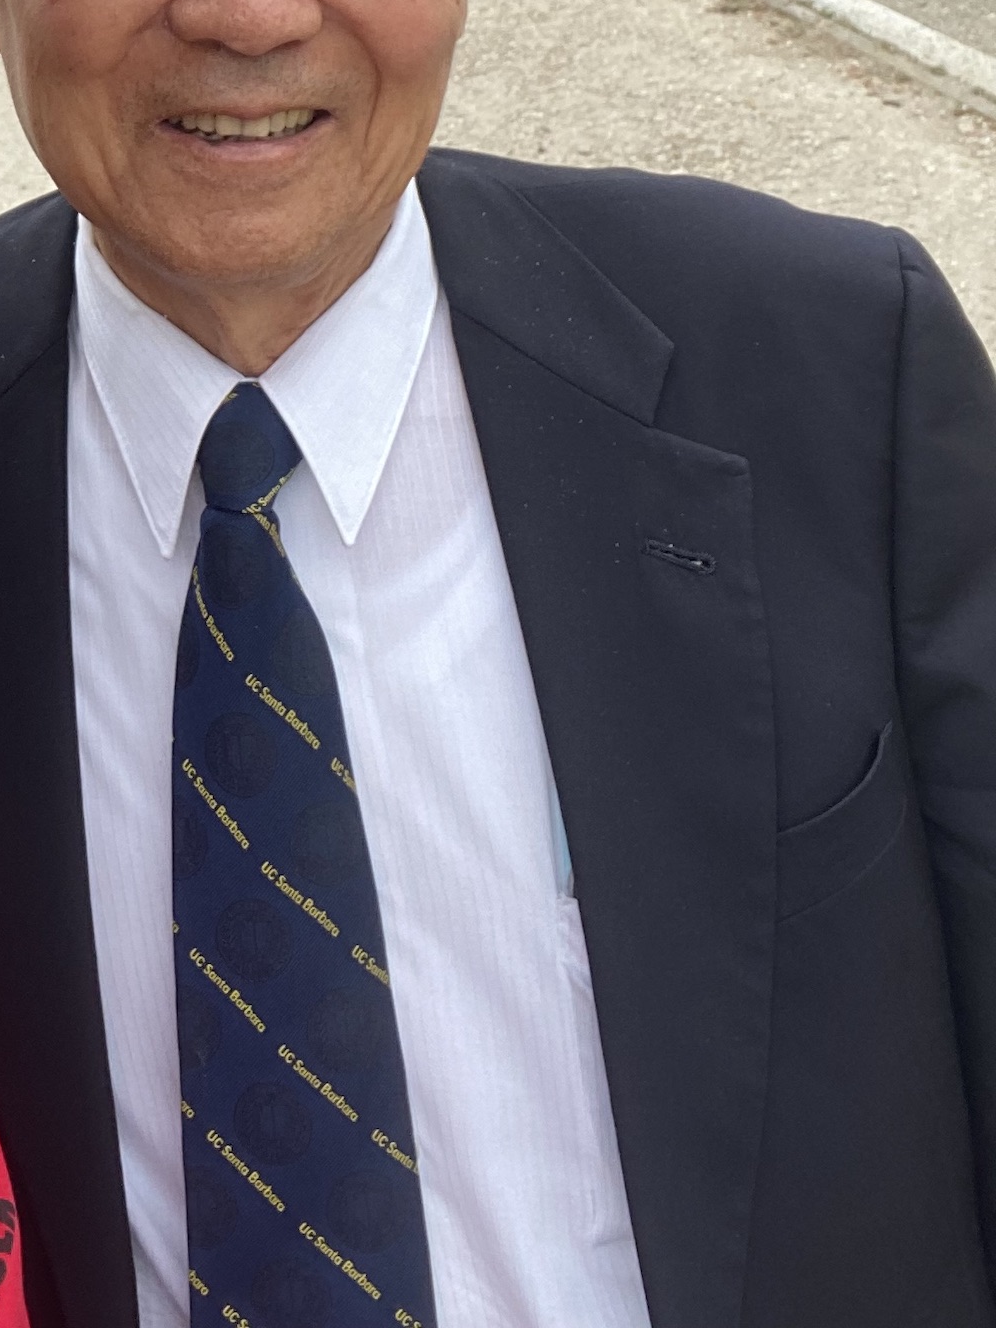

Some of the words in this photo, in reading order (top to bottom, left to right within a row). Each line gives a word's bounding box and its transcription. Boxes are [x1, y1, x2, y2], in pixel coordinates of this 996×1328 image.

[206, 615, 235, 662] Barbara
[245, 673, 263, 693] UC
[259, 686, 287, 717] Santa
[284, 709, 321, 750] Barbara
[182, 758, 197, 779] UC
[193, 776, 218, 810] Santa
[215, 805, 250, 850] Barbara
[330, 757, 345, 777] UC
[261, 861, 279, 880] UC
[275, 875, 305, 905] Santa
[302, 898, 340, 937] Barbara
[189, 947, 206, 967] UC
[203, 963, 231, 995] Santa
[229, 989, 266, 1033] Barbara
[351, 944, 369, 964] UC
[277, 1044, 296, 1064] UC
[292, 1059, 322, 1089] Santa
[320, 1083, 359, 1122] Barbara
[207, 1129, 224, 1149] UC
[221, 1145, 250, 1176] Santa
[247, 1171, 286, 1213] Barbara
[370, 1128, 389, 1148] UC
[386, 1141, 414, 1170] Santa
[298, 1222, 317, 1240] UC
[313, 1236, 344, 1266] Santa
[341, 1260, 382, 1300] Barbara
[222, 1304, 240, 1323] UC
[394, 1308, 413, 1327] UC
